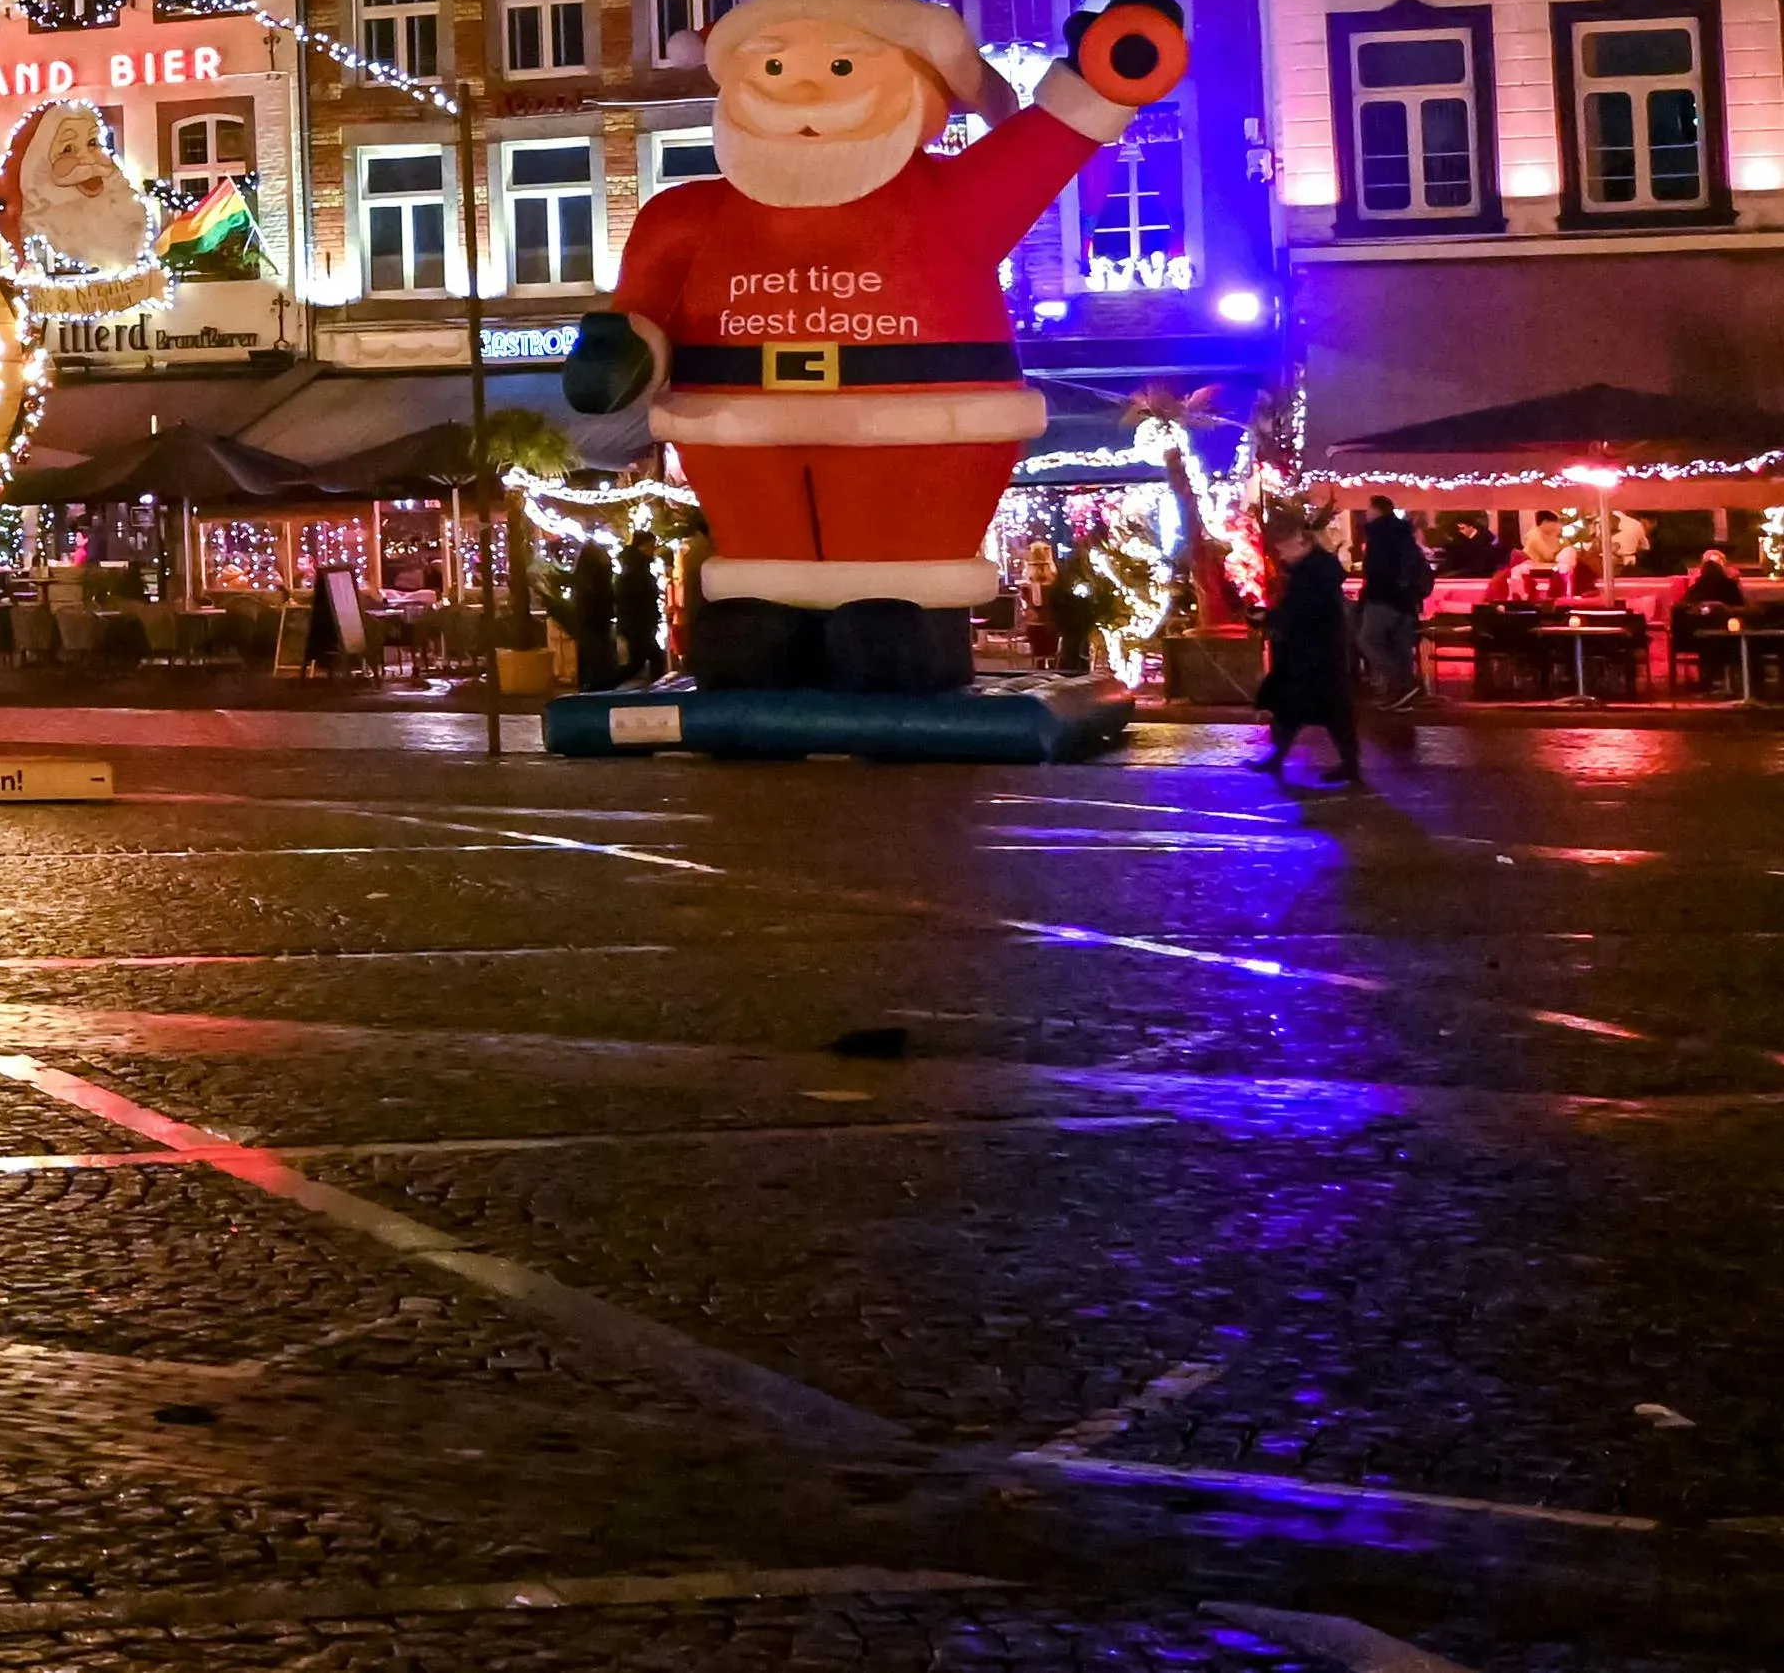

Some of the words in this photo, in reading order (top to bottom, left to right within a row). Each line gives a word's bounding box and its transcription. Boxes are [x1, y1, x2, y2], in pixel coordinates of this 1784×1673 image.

[110, 46, 222, 88] BIER
[730, 268, 799, 303] pret
[807, 265, 883, 299] tige
[719, 309, 797, 336] feest
[805, 306, 919, 341] dagen
